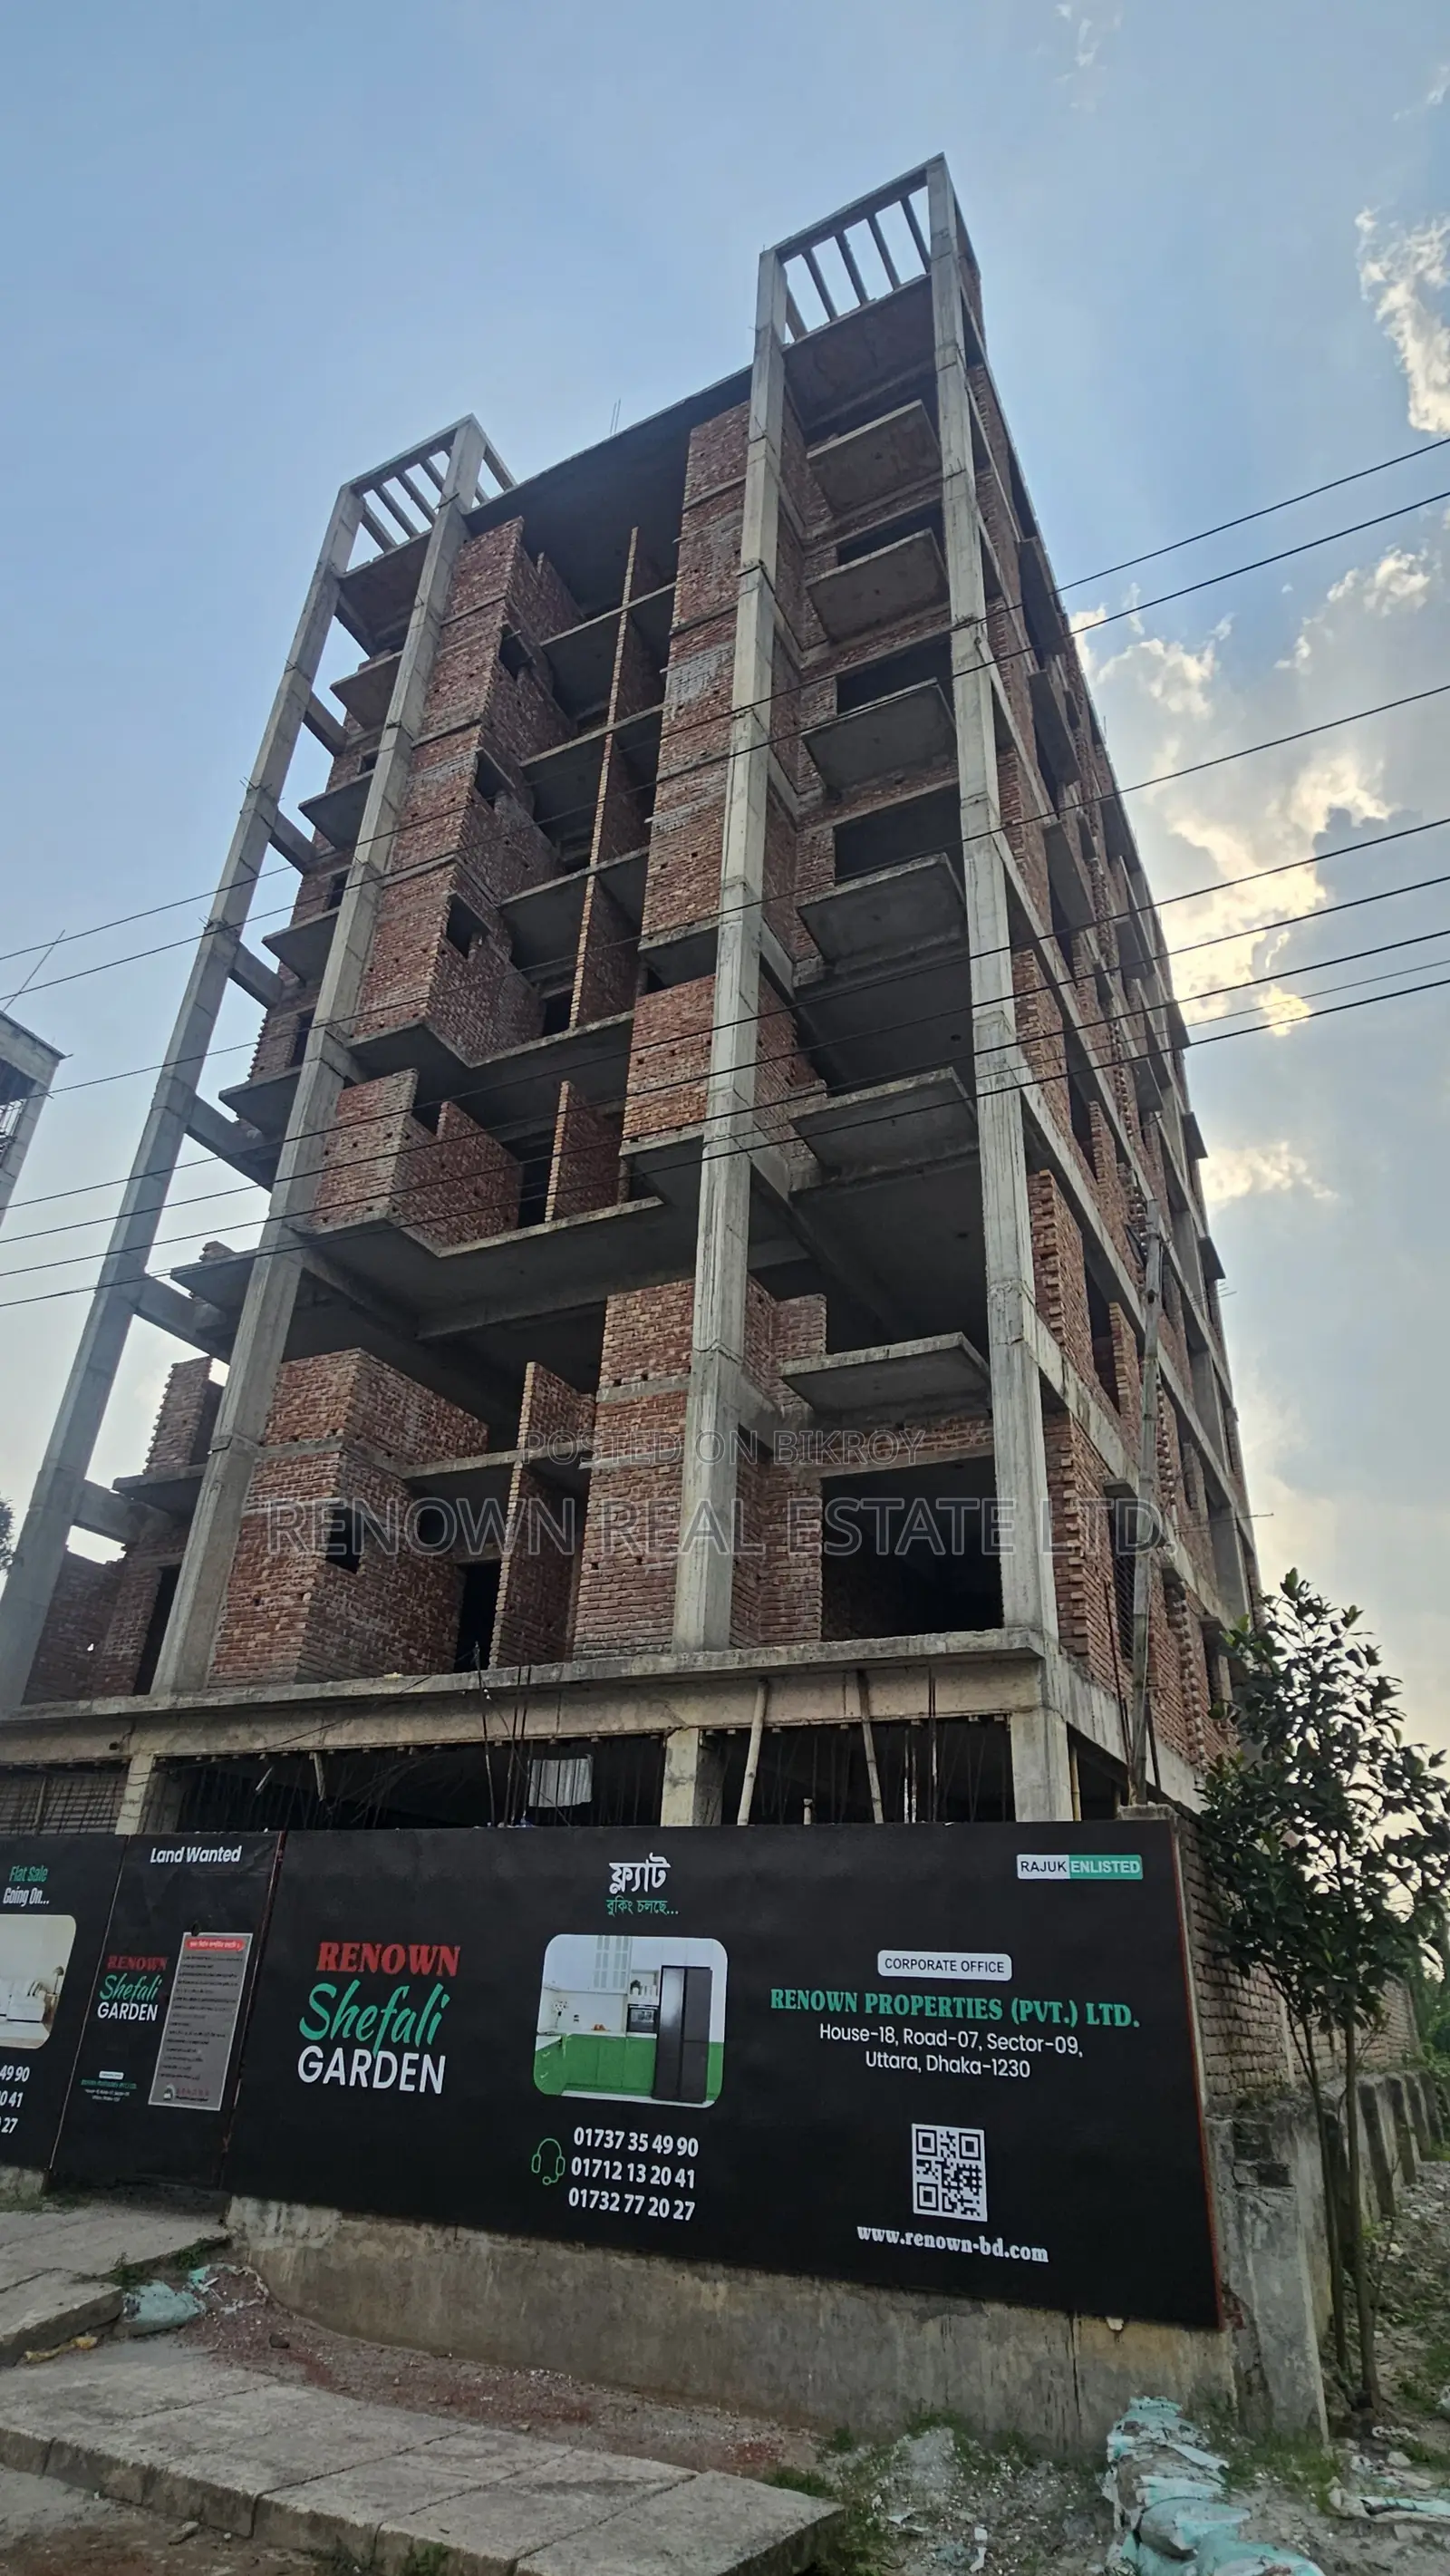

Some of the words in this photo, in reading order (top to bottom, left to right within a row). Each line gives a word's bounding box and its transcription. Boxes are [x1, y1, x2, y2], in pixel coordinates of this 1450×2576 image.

[150, 1846, 185, 1863] Land
[186, 1845, 243, 1863] Wanted
[1020, 1861, 1067, 1873] RAJUK
[1070, 1860, 1141, 1874] ENLISTED
[9, 1865, 27, 1882] Flat
[27, 1864, 48, 1883] Sale
[609, 1852, 671, 1894] ফ্ল্যাট
[3, 1886, 29, 1907] Going
[29, 1887, 50, 1904] On...
[606, 1895, 633, 1917] বুকিং
[636, 1900, 679, 1915] চলছে...
[106, 1955, 169, 1971] RENOWN
[315, 1942, 461, 1977] RENOWN
[884, 1958, 958, 1972] CORPORATE
[961, 1961, 1005, 1974] OFFICE
[99, 1972, 163, 2004] Shefali
[97, 2001, 159, 2021] GARDEN
[299, 1979, 450, 2059] Shefali
[770, 1989, 858, 2013] RENOWN
[865, 1992, 1003, 2020] PROPERTIES
[1011, 1997, 1078, 2028] (PVT.)
[1086, 2002, 1140, 2028] LTD.
[820, 2023, 899, 2047] House-18,
[903, 2028, 982, 2051] Road-07,
[987, 2032, 1083, 2058] Sector-09,
[14, 2066, 30, 2082] 90
[297, 2045, 447, 2094] GARDEN
[865, 2050, 922, 2073] Uttara,
[926, 2055, 1031, 2077] Dhaka-1230
[0, 2089, 8, 2106] 0
[8, 2091, 24, 2108] 41
[1, 2116, 18, 2134] 27
[574, 2126, 624, 2149] 01737
[627, 2132, 649, 2152] 35
[652, 2134, 673, 2155] 49
[677, 2136, 699, 2157] 90
[571, 2156, 623, 2180] 01712
[627, 2163, 646, 2183] 13
[650, 2165, 672, 2186] 20
[674, 2168, 695, 2189] 41
[568, 2187, 620, 2212] 01732
[624, 2193, 644, 2214] 77
[648, 2196, 670, 2218] 20
[672, 2200, 695, 2221] 27
[856, 2226, 1049, 2262] www.renown-bd.com
